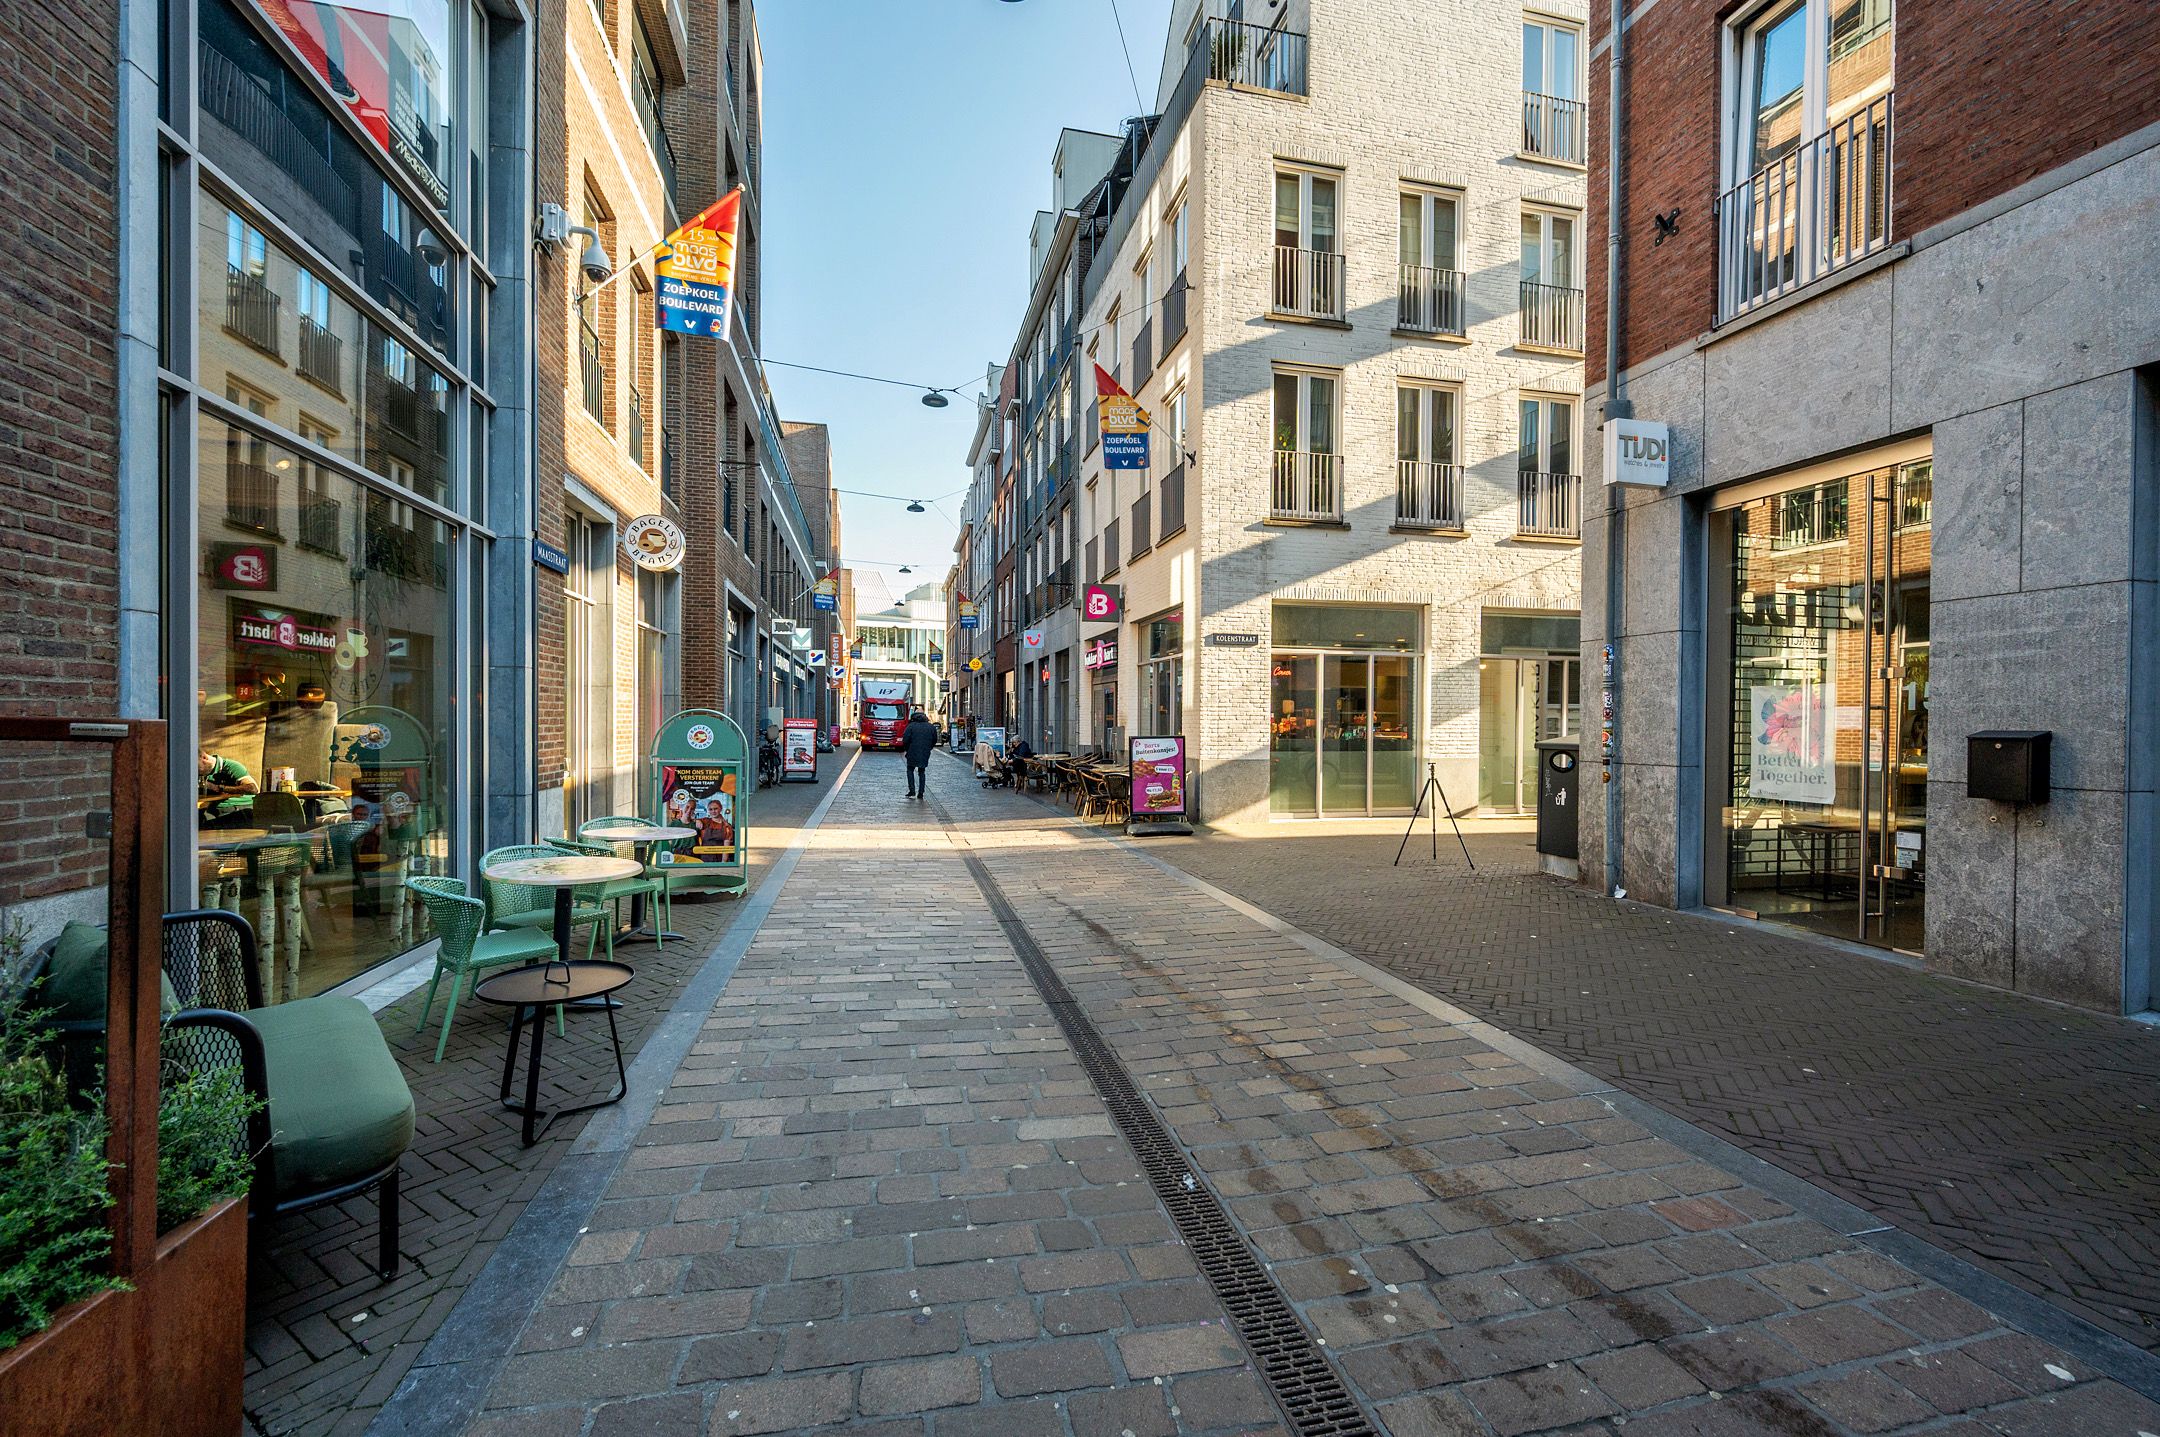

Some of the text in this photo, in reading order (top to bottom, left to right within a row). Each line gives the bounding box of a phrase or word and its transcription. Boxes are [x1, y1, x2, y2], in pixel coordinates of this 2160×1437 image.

[689, 229, 704, 242] 15
[674, 241, 717, 257] maas
[672, 249, 717, 271] blvd
[663, 282, 720, 301] ZOEPKOEL
[659, 296, 724, 315] BOULEVARD
[1109, 407, 1136, 415] maas
[1105, 446, 1145, 454] BOULEVARD
[632, 518, 676, 537] BAGELS
[537, 546, 567, 569] MAASSTRAAT
[632, 549, 673, 564] BEANS
[1090, 593, 1109, 615] B
[1216, 635, 1256, 643] KOLENSTRAAT
[1758, 769, 1828, 786] Together.
